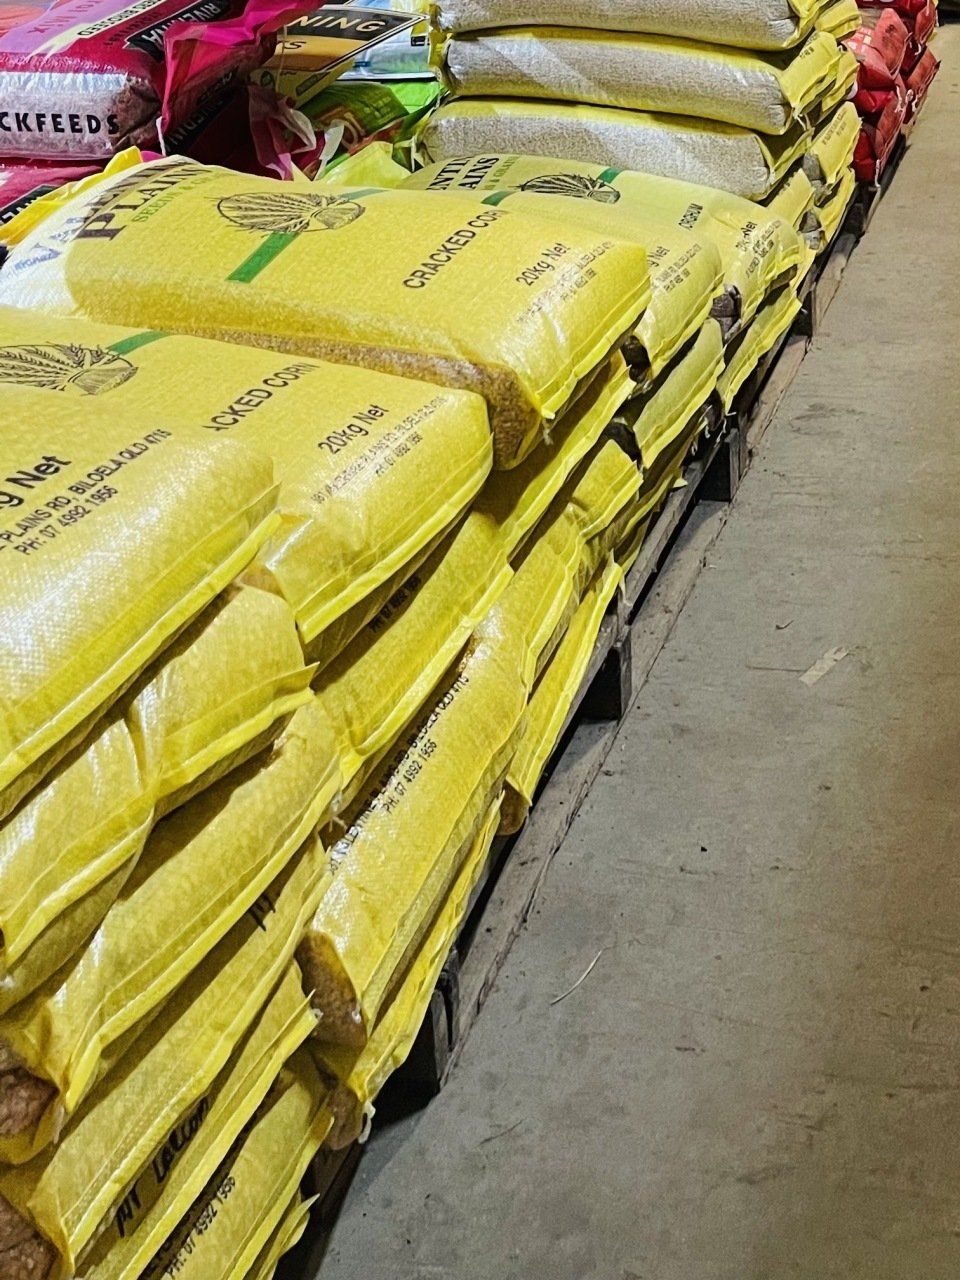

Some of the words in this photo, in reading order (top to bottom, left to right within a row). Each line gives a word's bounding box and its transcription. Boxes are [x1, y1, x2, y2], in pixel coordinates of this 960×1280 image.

[401, 228, 477, 290] CRACKED
[515, 258, 556, 288] 20kg
[541, 242, 571, 265] Net
[262, 362, 321, 388] CORN
[317, 422, 369, 456] 20kg
[355, 403, 390, 428] Net
[0, 508, 53, 544] PLAINS
[67, 458, 127, 495] BILOELA
[119, 442, 149, 461] QLD
[5, 455, 73, 490] Net
[13, 536, 47, 556] PH:
[39, 524, 62, 539] 07
[57, 505, 92, 528] 4992
[393, 779, 408, 797] 07
[402, 759, 425, 784] 4992
[417, 738, 439, 763] 1956
